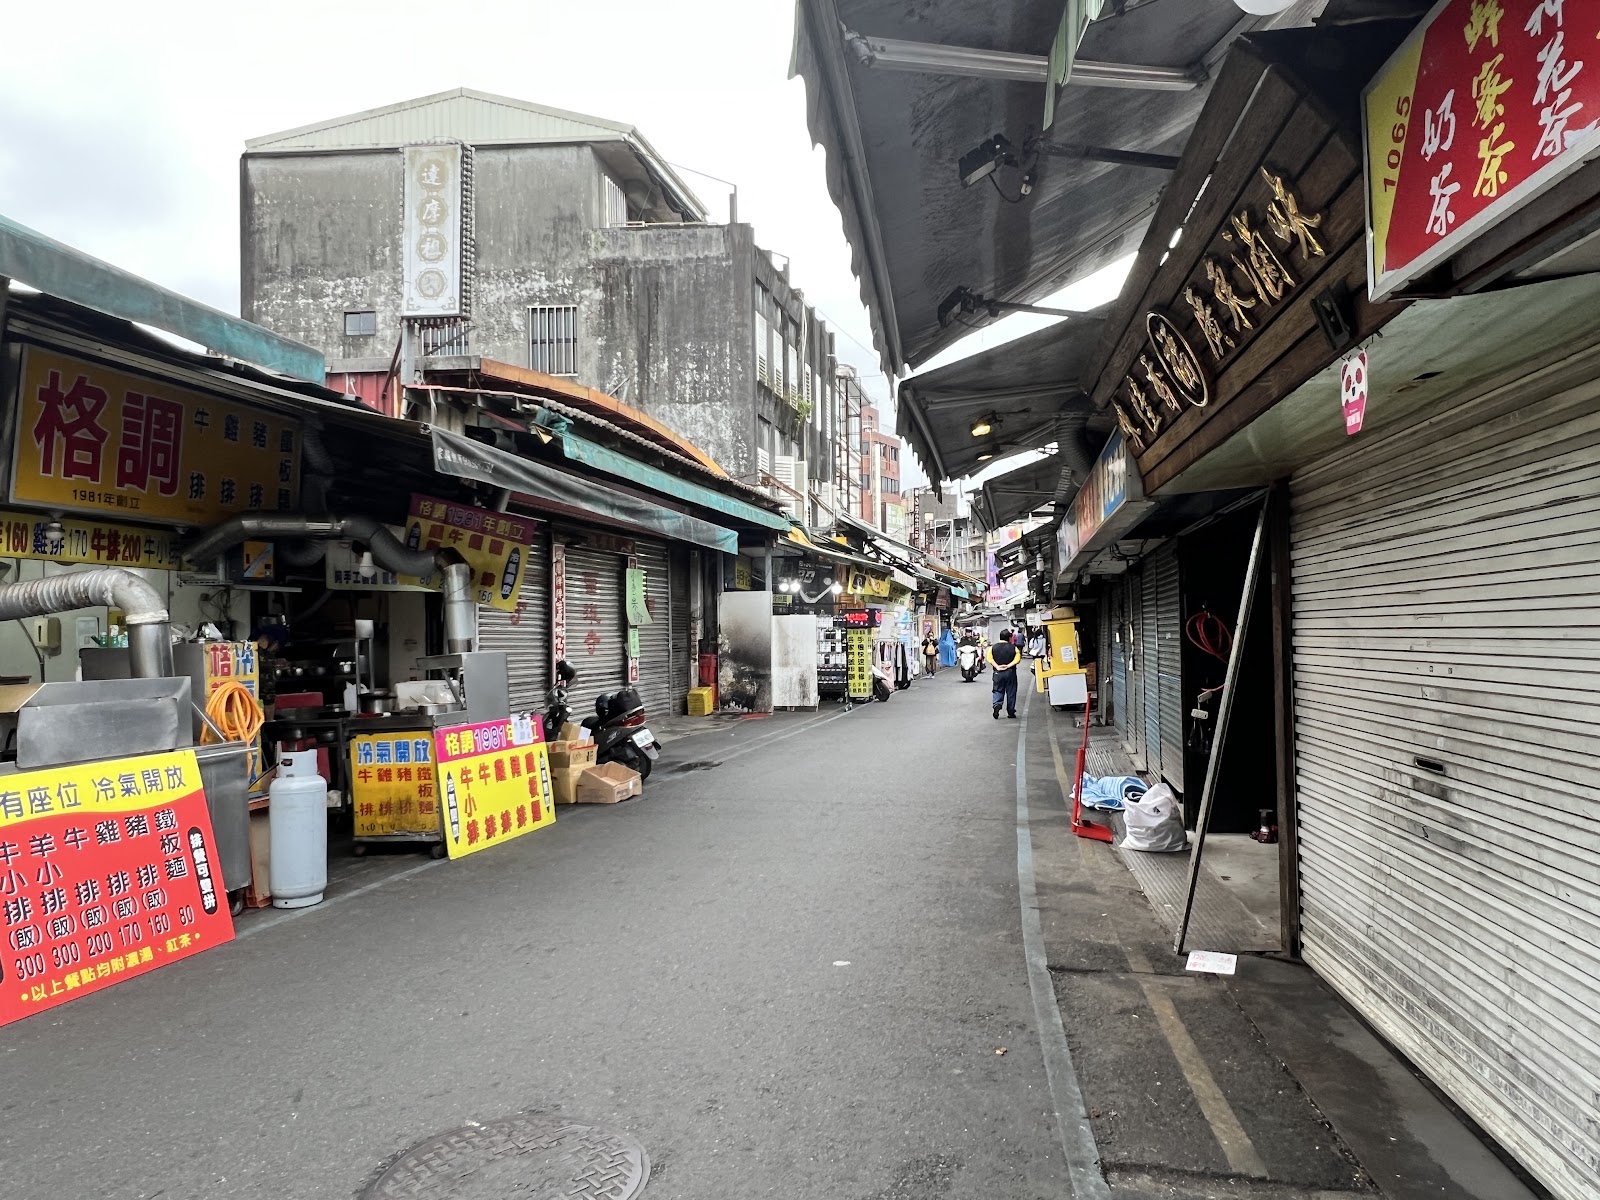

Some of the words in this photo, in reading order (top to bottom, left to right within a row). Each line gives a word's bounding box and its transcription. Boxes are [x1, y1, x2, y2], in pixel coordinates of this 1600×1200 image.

[1383, 95, 1411, 193] 1065
[1421, 88, 1461, 236] 奶茶
[33, 369, 185, 497] 格調
[72, 487, 141, 510] 1981年創立
[357, 738, 432, 765] 冷氣開放
[0, 781, 81, 819] 有座位
[91, 764, 187, 803] 冷氣開放
[153, 808, 189, 880] 鐵板麵
[86, 931, 114, 957] 200
[118, 922, 142, 948] 170
[14, 952, 46, 982] 300
[52, 941, 81, 969] 300
